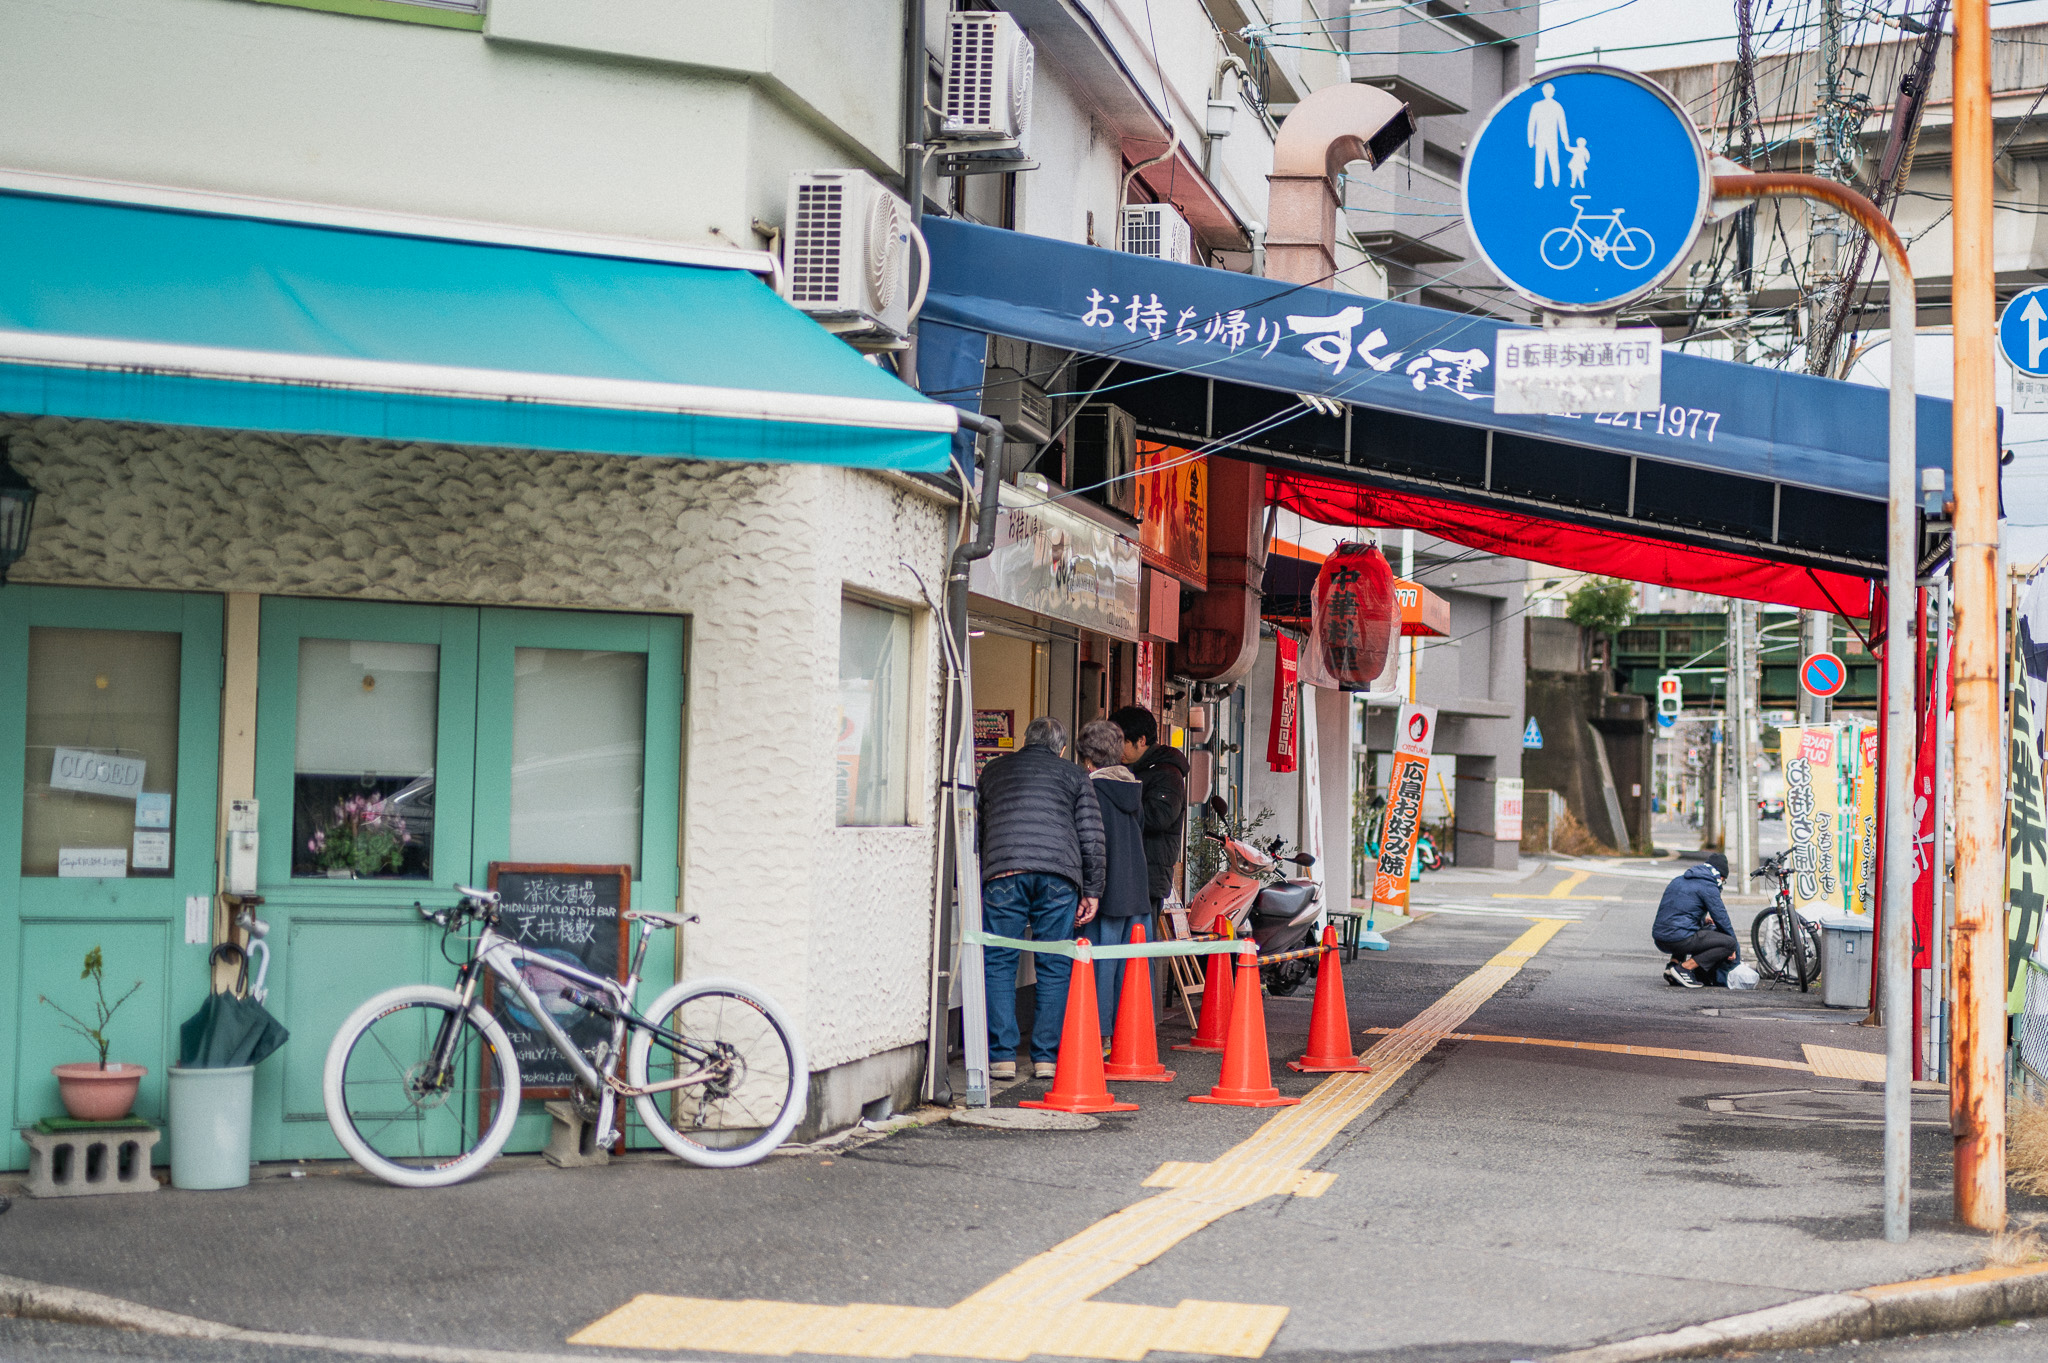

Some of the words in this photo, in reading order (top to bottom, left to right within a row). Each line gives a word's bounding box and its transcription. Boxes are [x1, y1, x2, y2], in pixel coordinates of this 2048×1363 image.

[1081, 288, 1281, 359] お持ち帰り
[1507, 341, 1652, 368] 自転車歩道通行可
[1327, 565, 1361, 671] 中華料理
[60, 756, 138, 786] CLOSED
[1378, 761, 1427, 877] 広島お好み焼
[524, 879, 596, 906] 深夜酒場
[500, 903, 551, 913] MIDNIGHT
[551, 905, 568, 913] OLD
[569, 905, 595, 916] STYLE
[597, 906, 616, 917] BAR
[507, 1032, 531, 1042] PEN
[521, 1073, 556, 1083] MOKING
